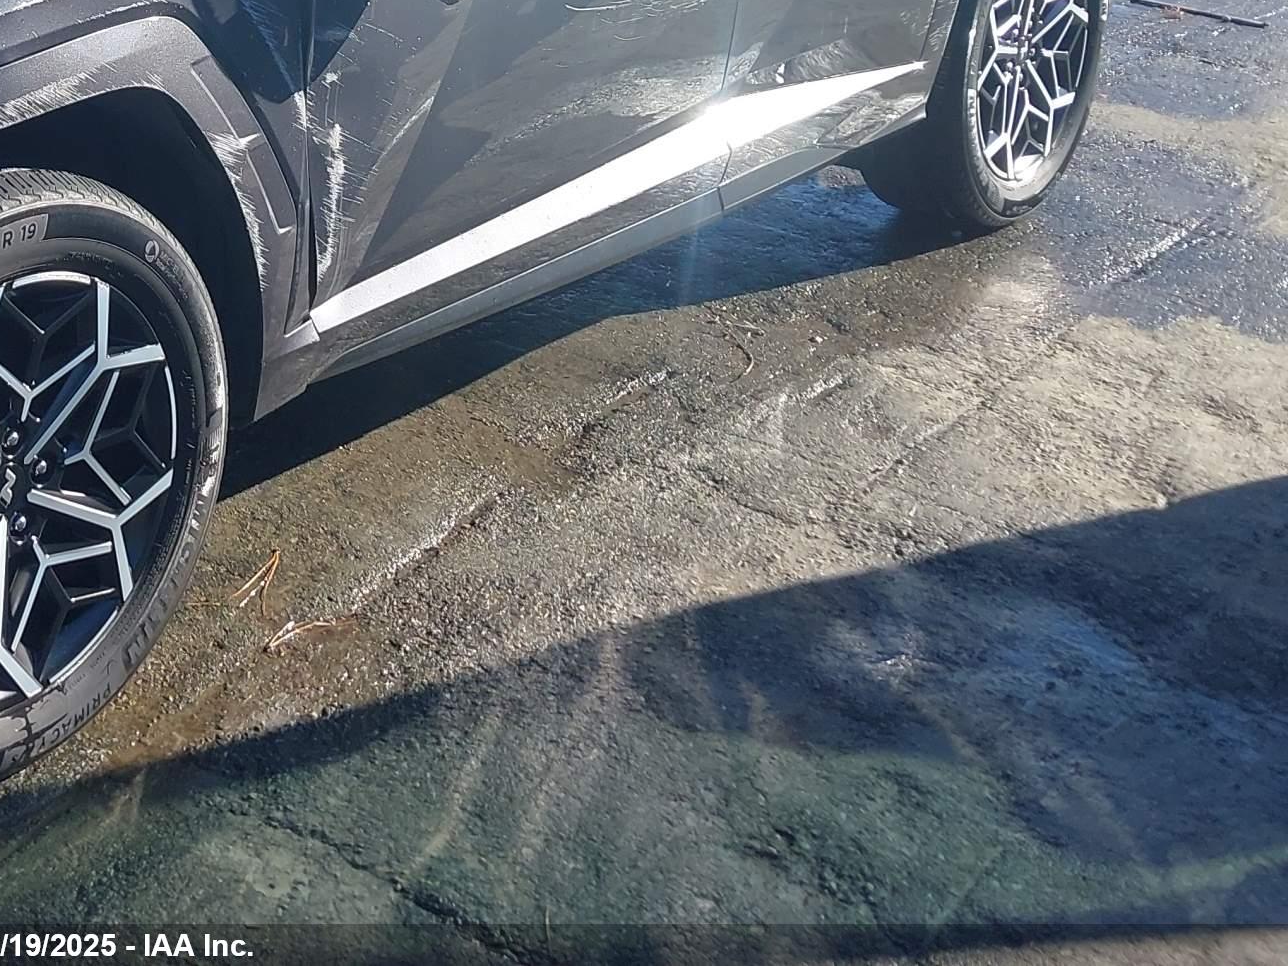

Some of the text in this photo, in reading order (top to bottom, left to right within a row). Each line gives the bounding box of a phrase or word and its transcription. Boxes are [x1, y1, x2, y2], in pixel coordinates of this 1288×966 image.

[2, 230, 13, 249] R
[20, 223, 37, 241] 19
[38, 682, 112, 752] PRIMACY
